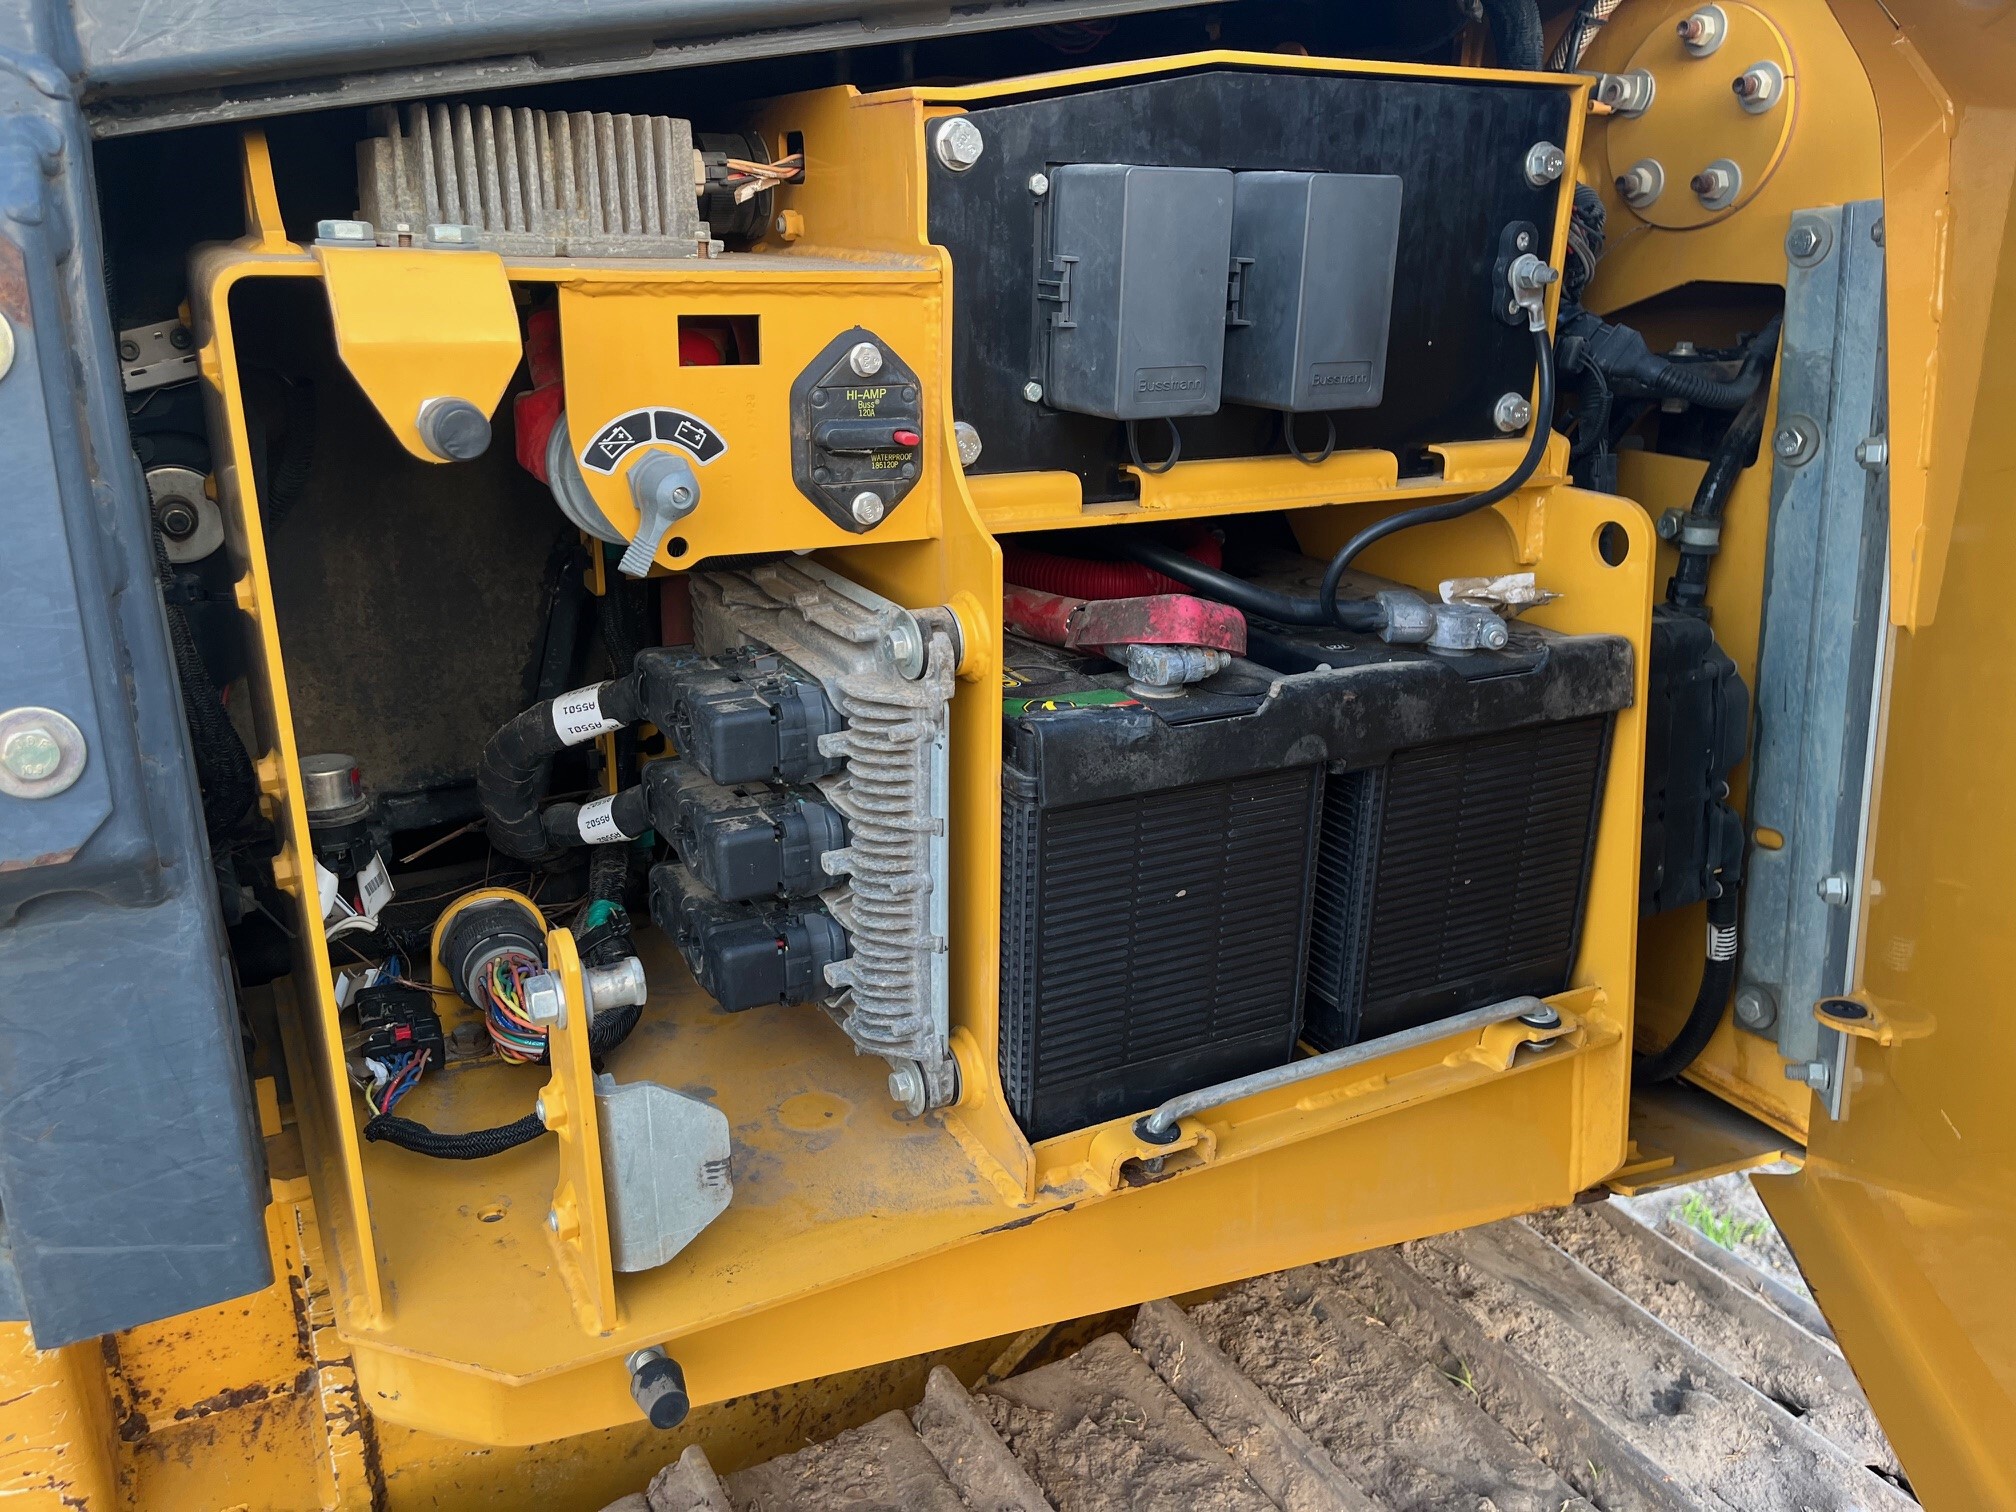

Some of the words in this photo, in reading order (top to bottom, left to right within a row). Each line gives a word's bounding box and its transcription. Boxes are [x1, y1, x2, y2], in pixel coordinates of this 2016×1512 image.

[1138, 379, 1202, 393] Bussmann
[1311, 374, 1368, 387] Bussmann
[846, 388, 887, 401] HI-AMP
[858, 408, 876, 417] 120A
[871, 452, 913, 462] WATERPROOF
[871, 461, 899, 470] 185120P
[563, 701, 596, 715] A5501
[567, 721, 602, 734] A5501
[585, 813, 611, 830] A5502
